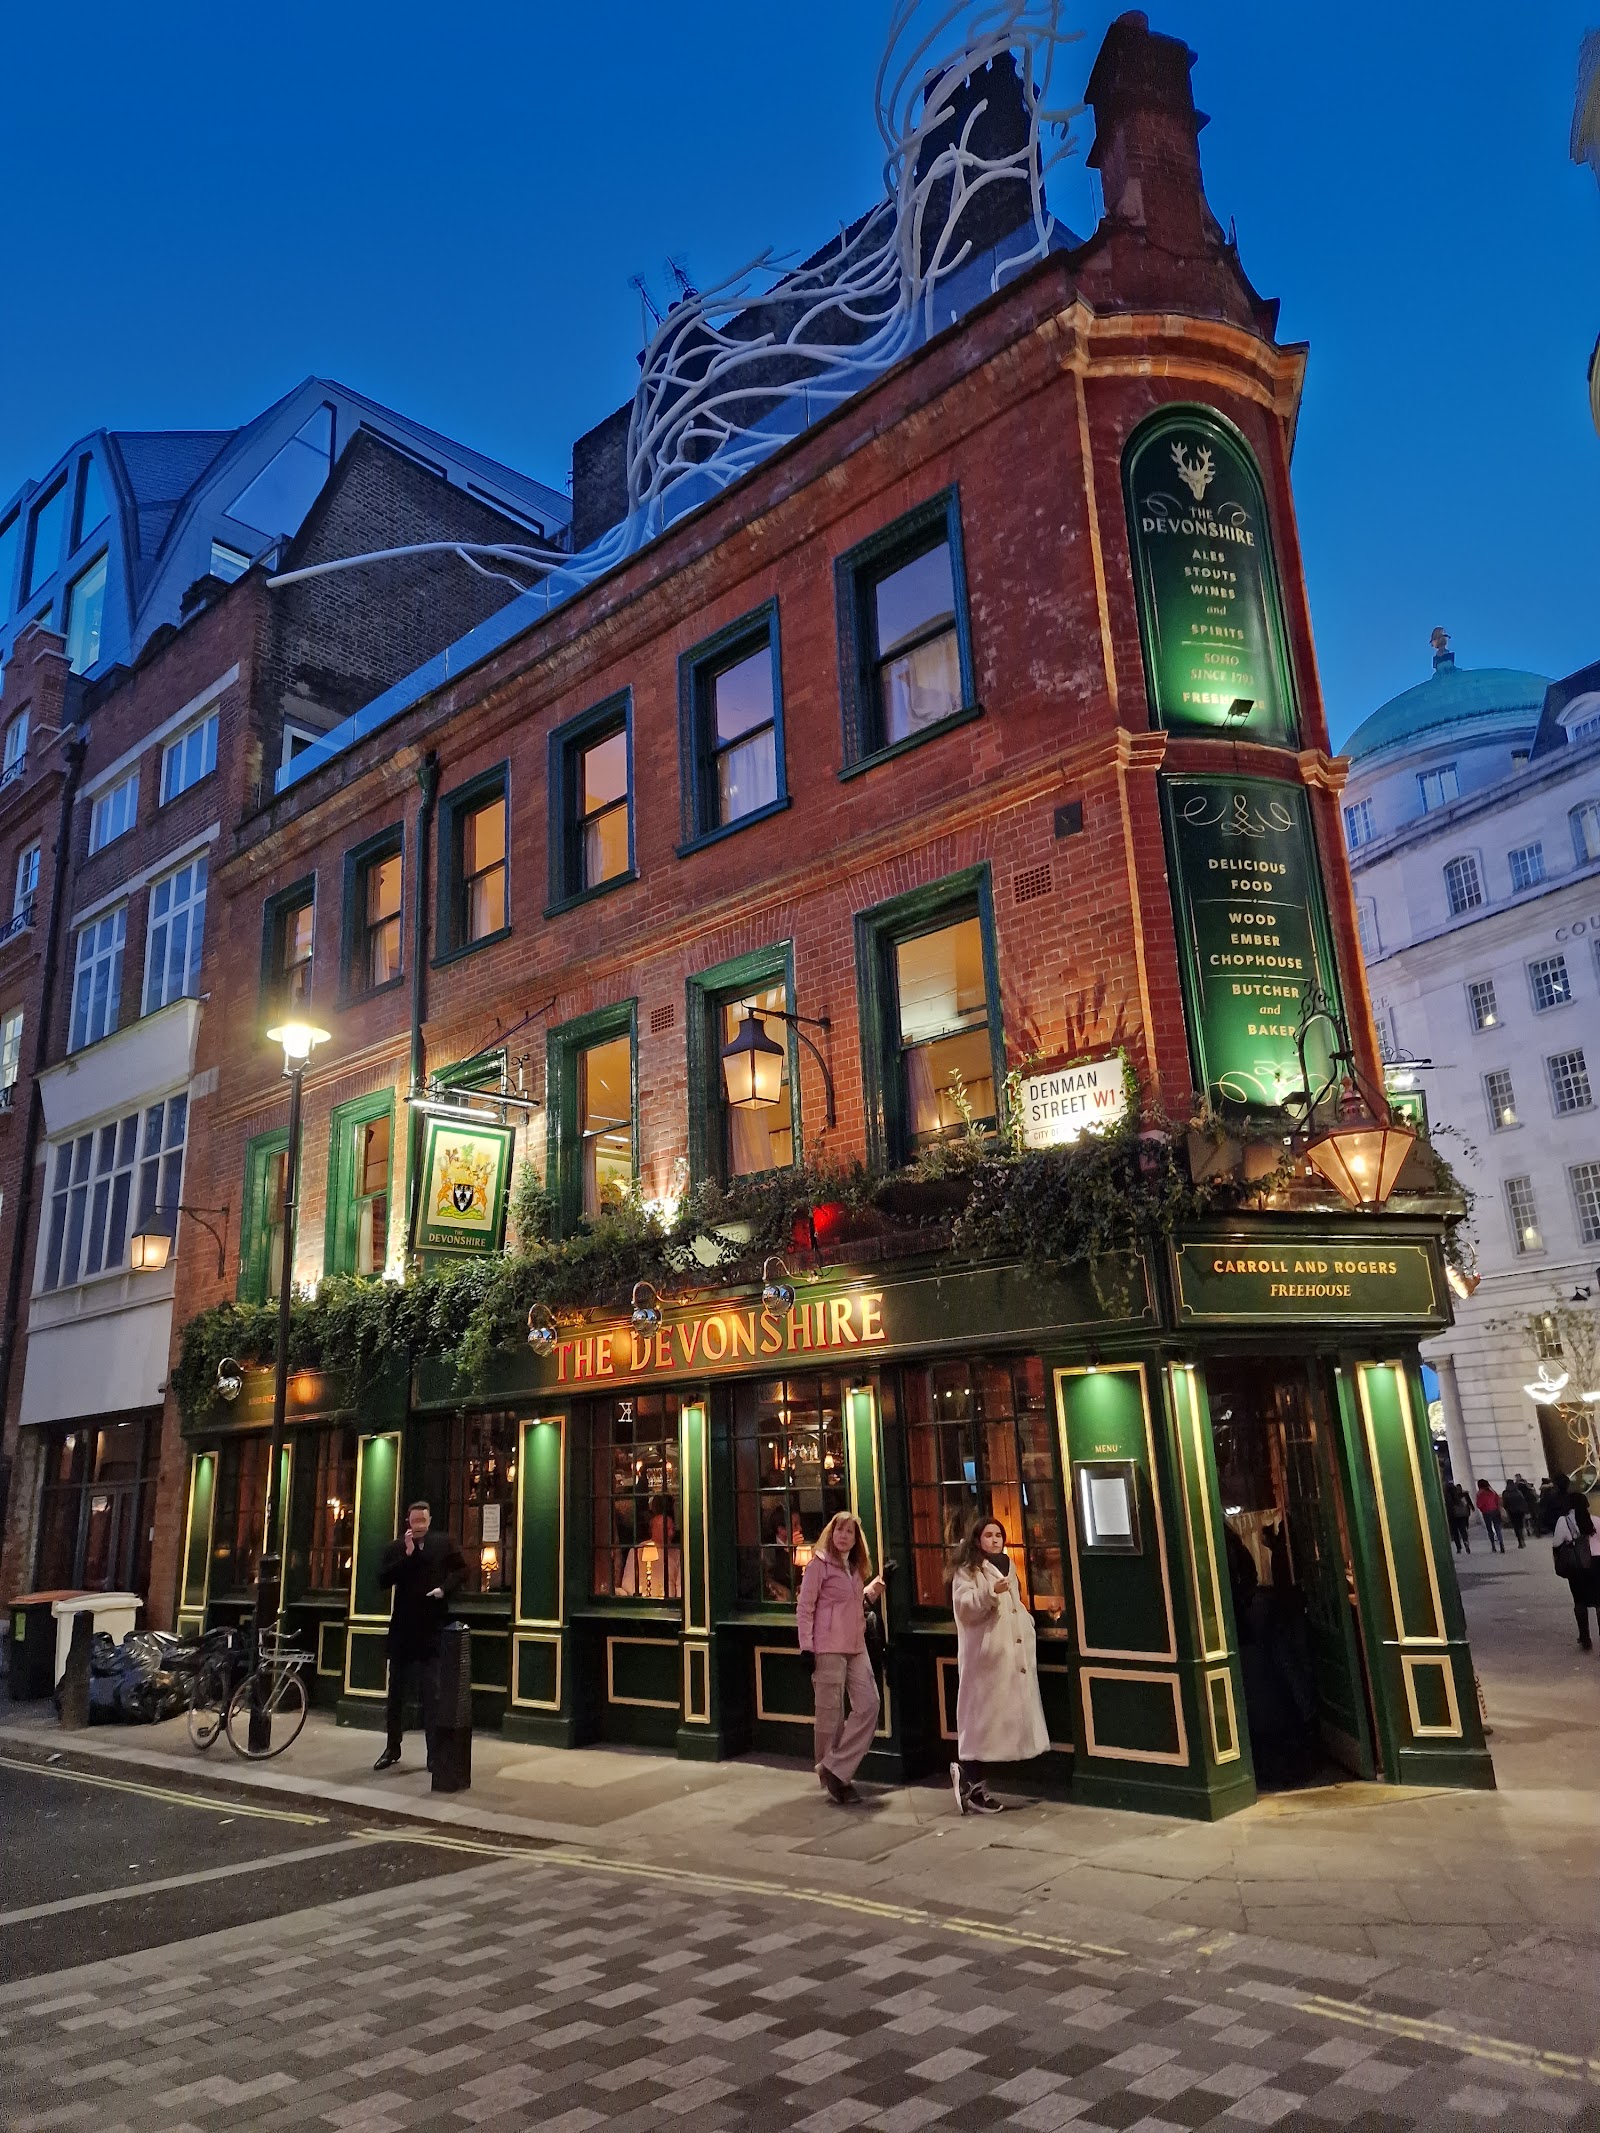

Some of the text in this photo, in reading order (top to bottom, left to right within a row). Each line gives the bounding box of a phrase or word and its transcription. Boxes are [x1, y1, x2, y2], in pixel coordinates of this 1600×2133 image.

[1188, 506, 1214, 520] THE
[1142, 518, 1255, 546] DEVONSHIRE
[1192, 549, 1225, 563] ALES
[1184, 566, 1237, 582] STOUTS
[1191, 584, 1236, 600] WINES
[1206, 605, 1227, 616] and
[1191, 624, 1245, 640] SPIRITS
[1204, 652, 1240, 666] SOHO
[1191, 668, 1227, 681] SINCE
[1183, 692, 1265, 709] FREEHE
[1208, 858, 1287, 875] DELICIOUS
[1231, 880, 1273, 892] FOOD
[1228, 913, 1277, 926] WOOD
[1231, 934, 1281, 947] EMBER
[1210, 954, 1303, 969] CHOPHOUSE
[1232, 984, 1300, 998] BUTCHER
[1259, 1004, 1281, 1015] and
[1248, 1024, 1296, 1037] BAKER
[1030, 1071, 1098, 1101] DENMAN
[1032, 1088, 1116, 1122] STREET W1
[1033, 1130, 1049, 1140] CITY
[429, 1233, 486, 1247] DEVONSHIRE
[1213, 1260, 1397, 1274] CARROLL AND ROGERS
[1270, 1284, 1352, 1297] FREEHOUSE
[553, 1293, 888, 1381] THE DEVONSHIRE
[1095, 1445, 1118, 1453] MENU
